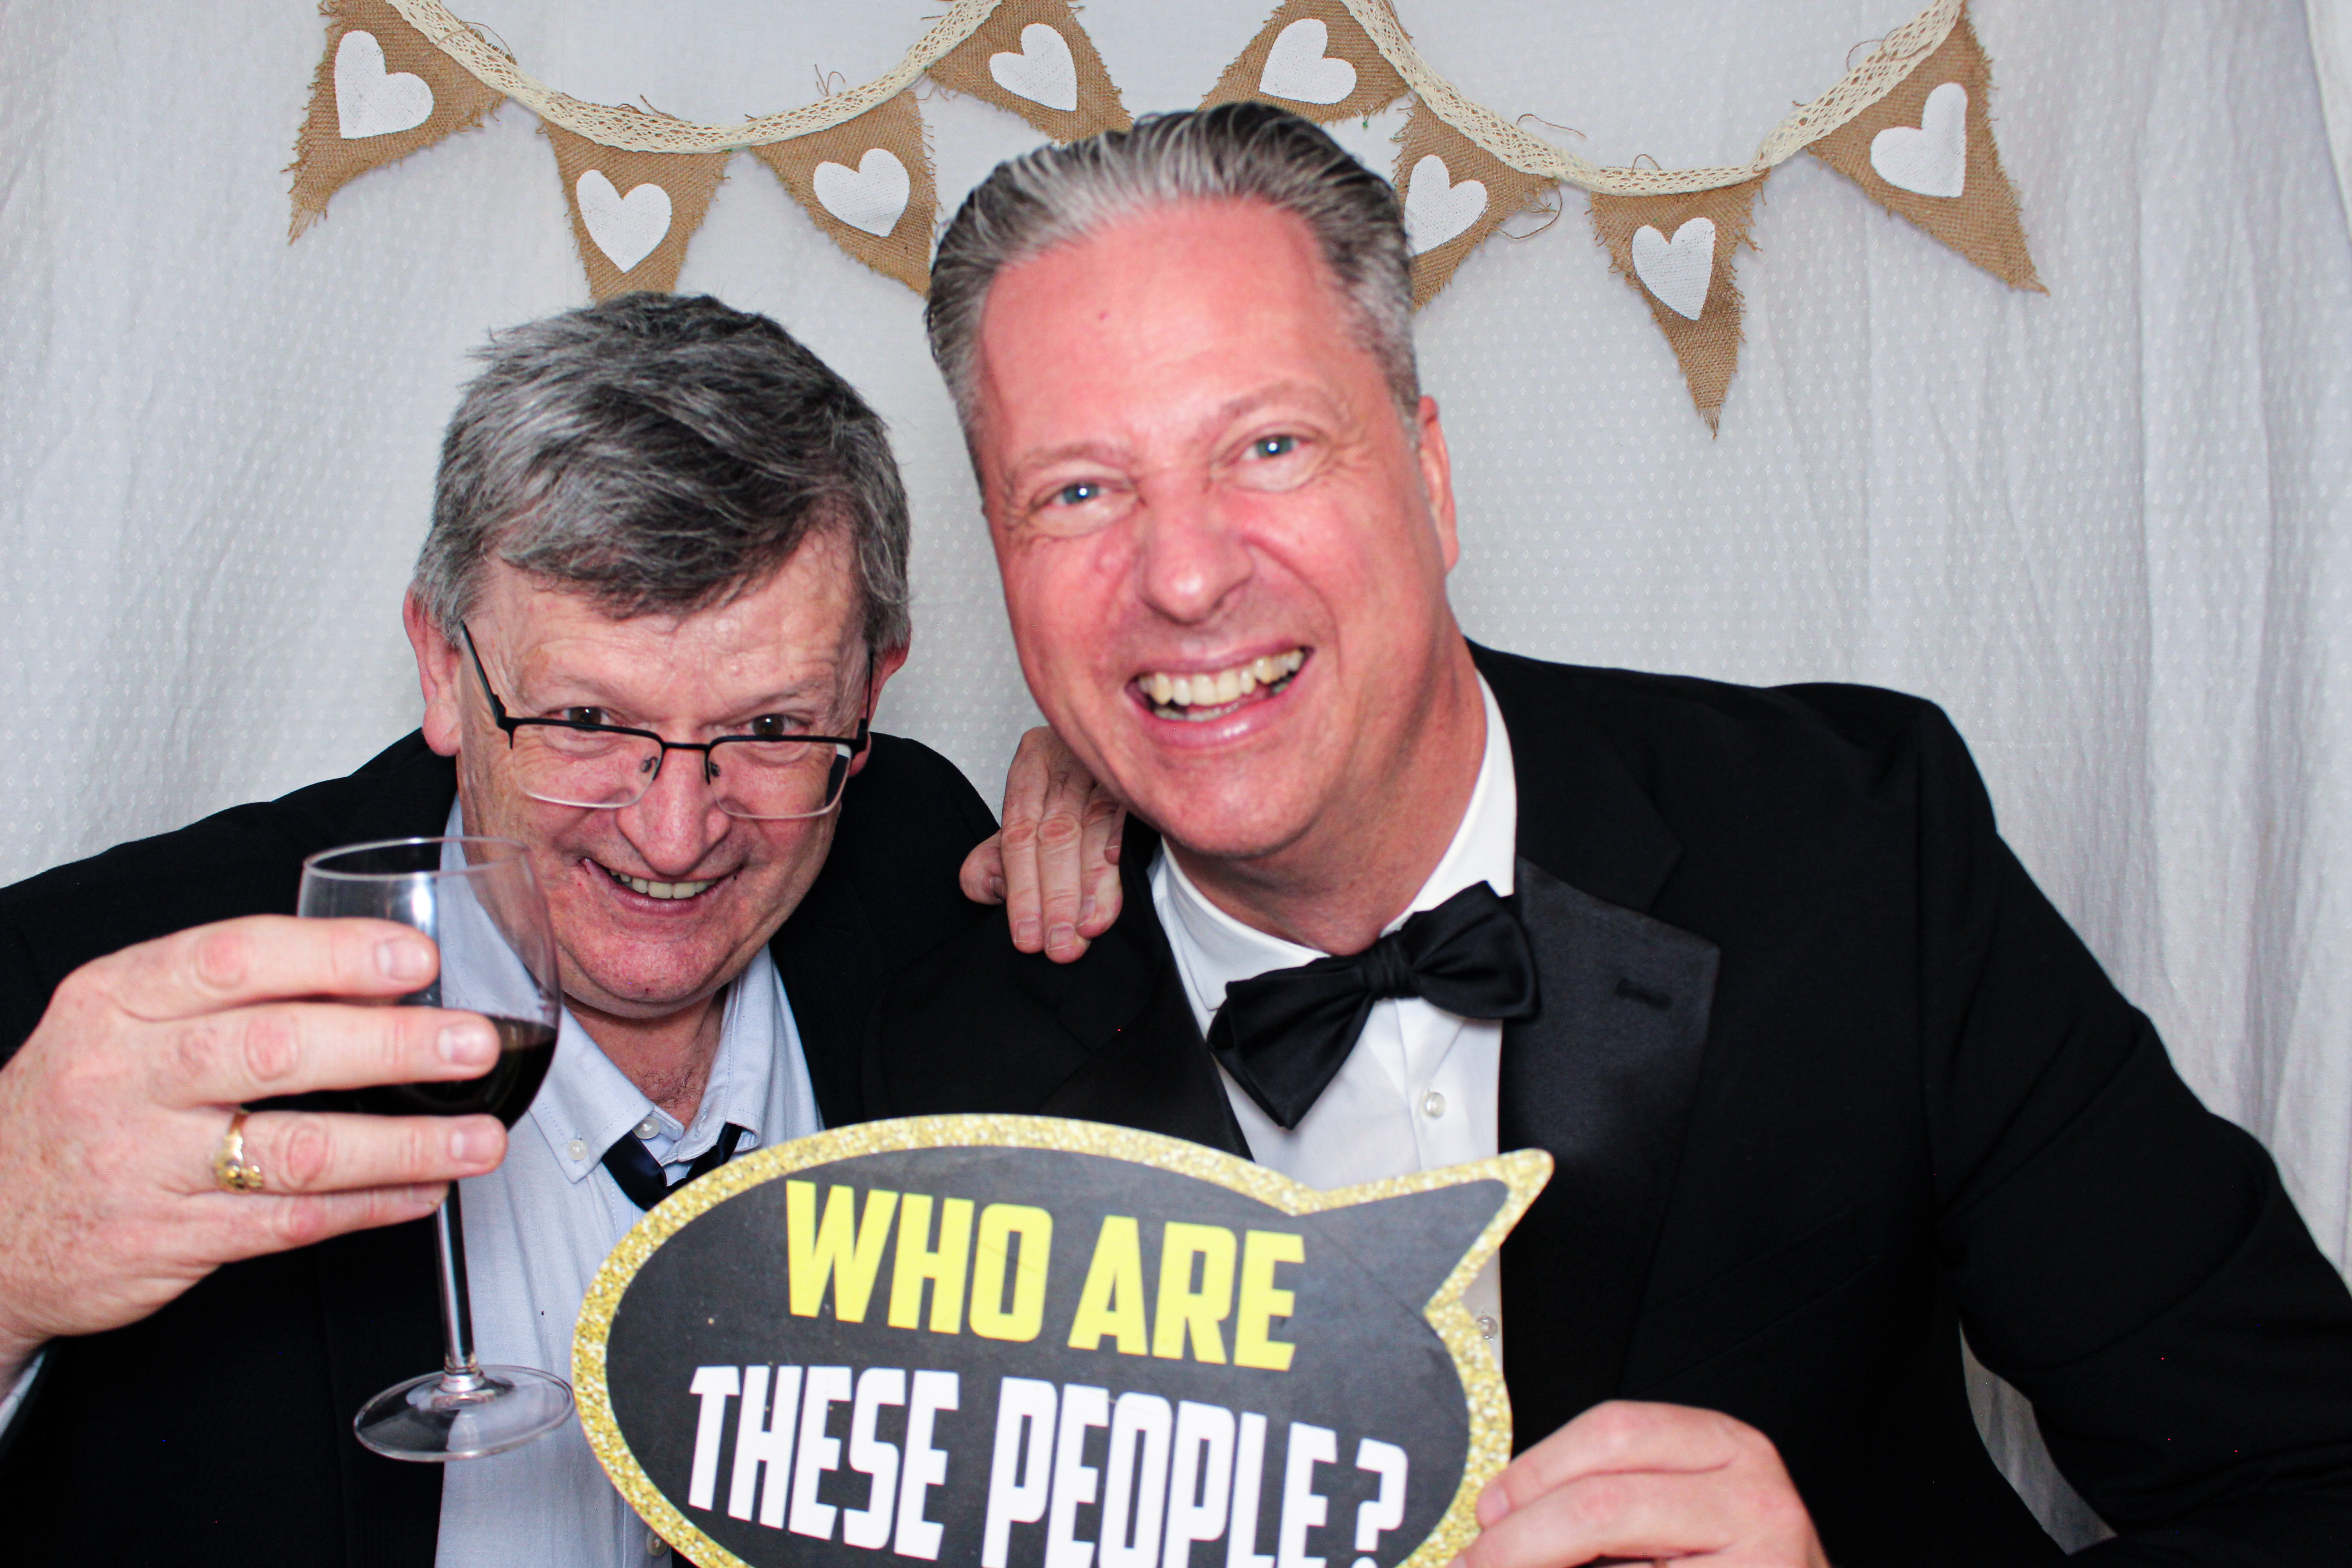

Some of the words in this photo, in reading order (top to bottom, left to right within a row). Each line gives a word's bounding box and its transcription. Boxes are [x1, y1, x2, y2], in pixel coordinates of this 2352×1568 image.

[786, 1180, 1054, 1342] WHO
[1067, 1215, 1306, 1371] ARE
[689, 1366, 959, 1560] THESE
[981, 1377, 1408, 1568] PEOPLE?
